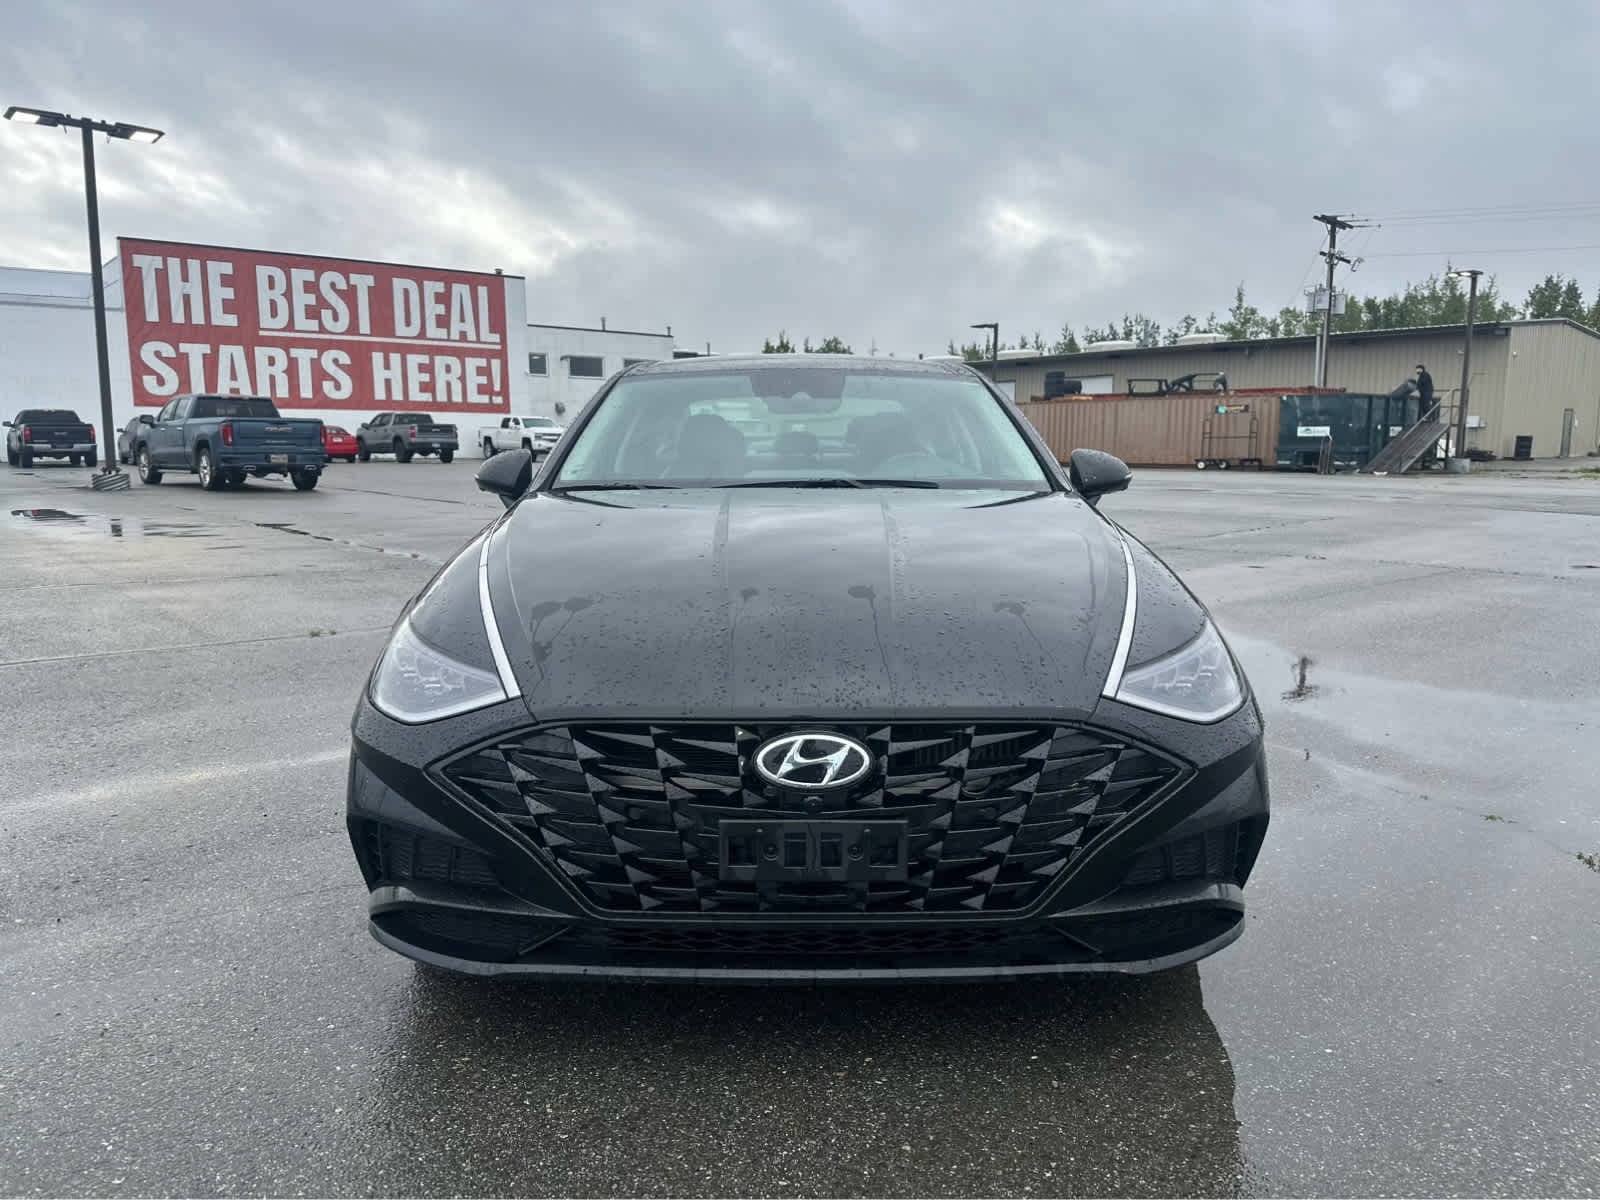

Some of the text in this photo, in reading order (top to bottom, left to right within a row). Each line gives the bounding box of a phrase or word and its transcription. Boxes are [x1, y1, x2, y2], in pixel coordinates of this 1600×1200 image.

[131, 254, 501, 343] THE BEST DEAL
[139, 341, 504, 404] STARTS HERE!
